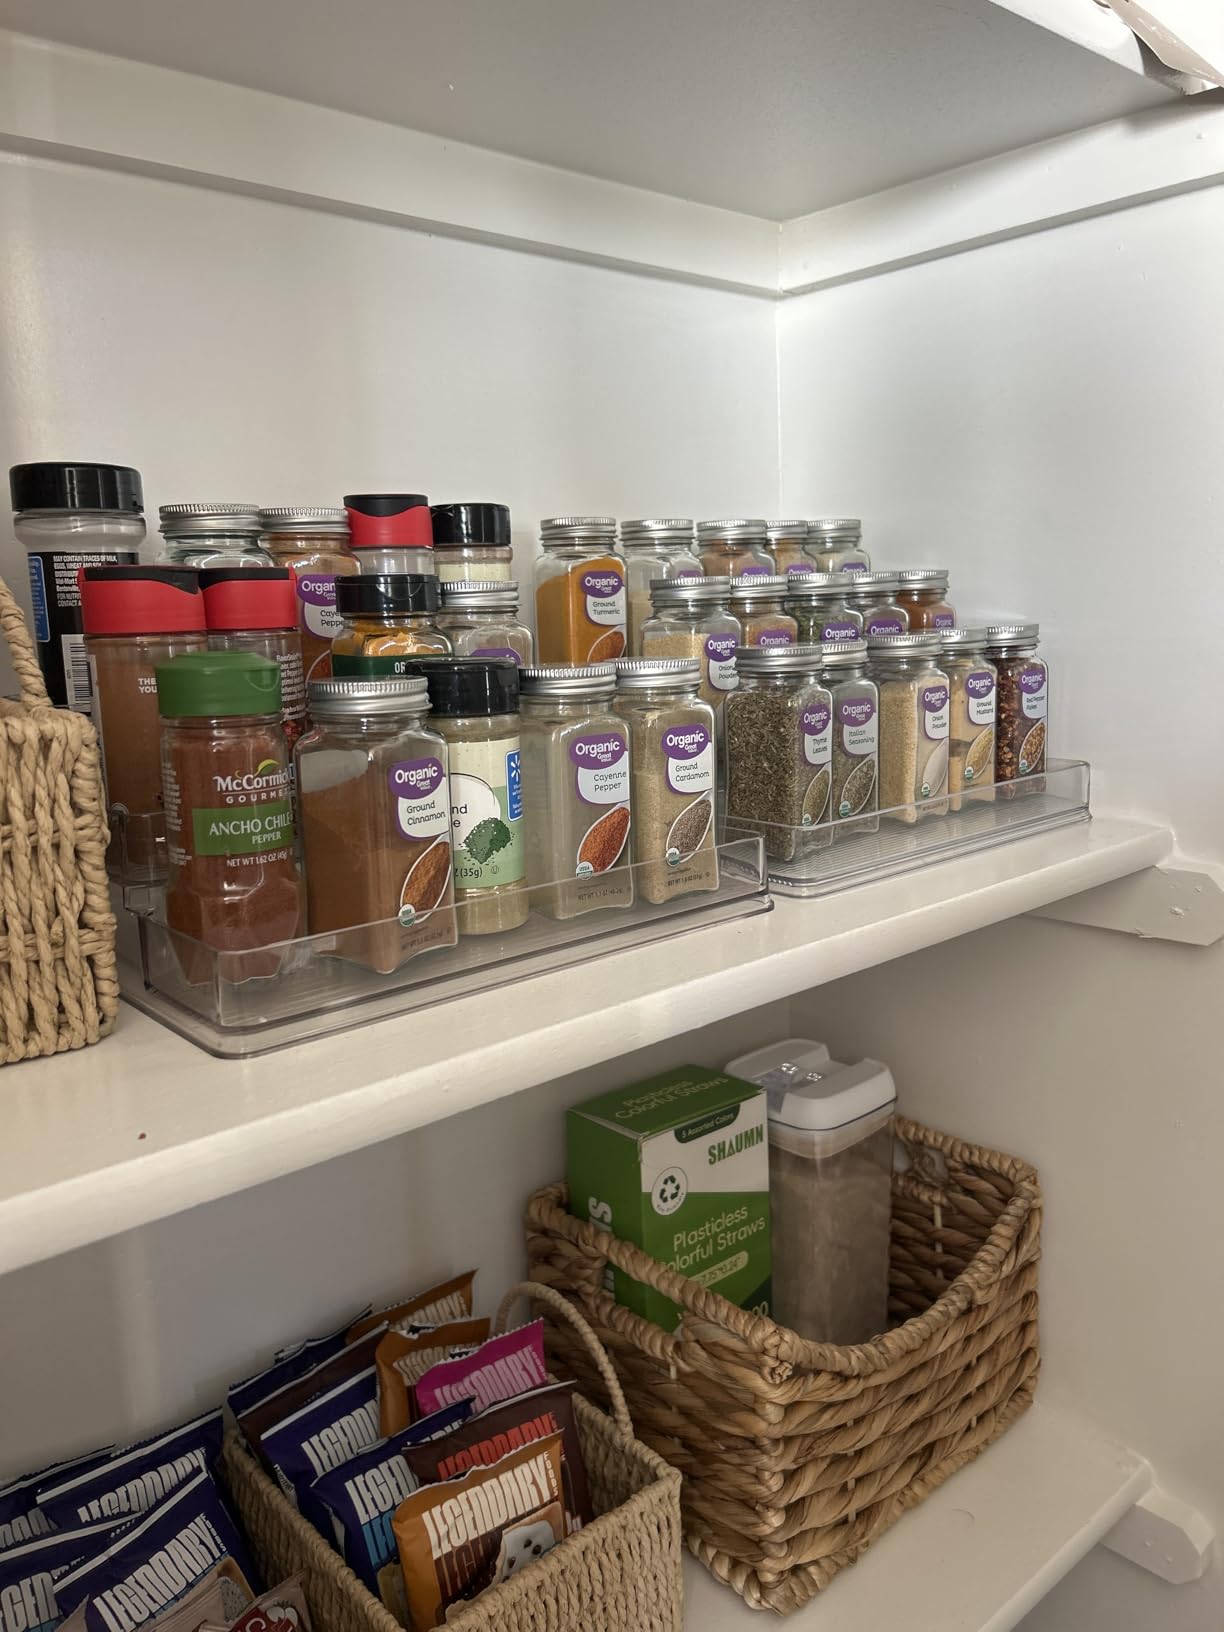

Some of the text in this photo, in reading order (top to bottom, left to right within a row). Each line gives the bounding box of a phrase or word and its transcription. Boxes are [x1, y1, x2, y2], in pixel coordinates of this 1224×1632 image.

[584, 575, 619, 589] Organic
[825, 626, 856, 640] Organic
[707, 638, 736, 653] Organic
[968, 677, 992, 690] Organic
[1022, 673, 1043, 686] Organic
[924, 690, 946, 703] Organic
[843, 702, 871, 717] Organic
[803, 709, 828, 726] Organic
[667, 730, 705, 749] Organic
[575, 738, 620, 757] Organic
[394, 764, 439, 786] Organic
[675, 762, 698, 773] Ground
[593, 770, 627, 782] Cayenne
[675, 770, 710, 782] Cardamom
[594, 782, 622, 793] Pepper
[406, 800, 435, 814] Ground
[407, 811, 446, 826] Cinnamon
[209, 818, 262, 836] ANCHO
[251, 831, 282, 844] PEPPER
[460, 867, 483, 879] (35g)
[707, 1124, 764, 1165] SHAUMN
[673, 1206, 749, 1252] Plasticless
[717, 1217, 766, 1251] Straws
[421, 1452, 551, 1561] LEGENDARY
[92, 1511, 222, 1632] LEGENDARY
